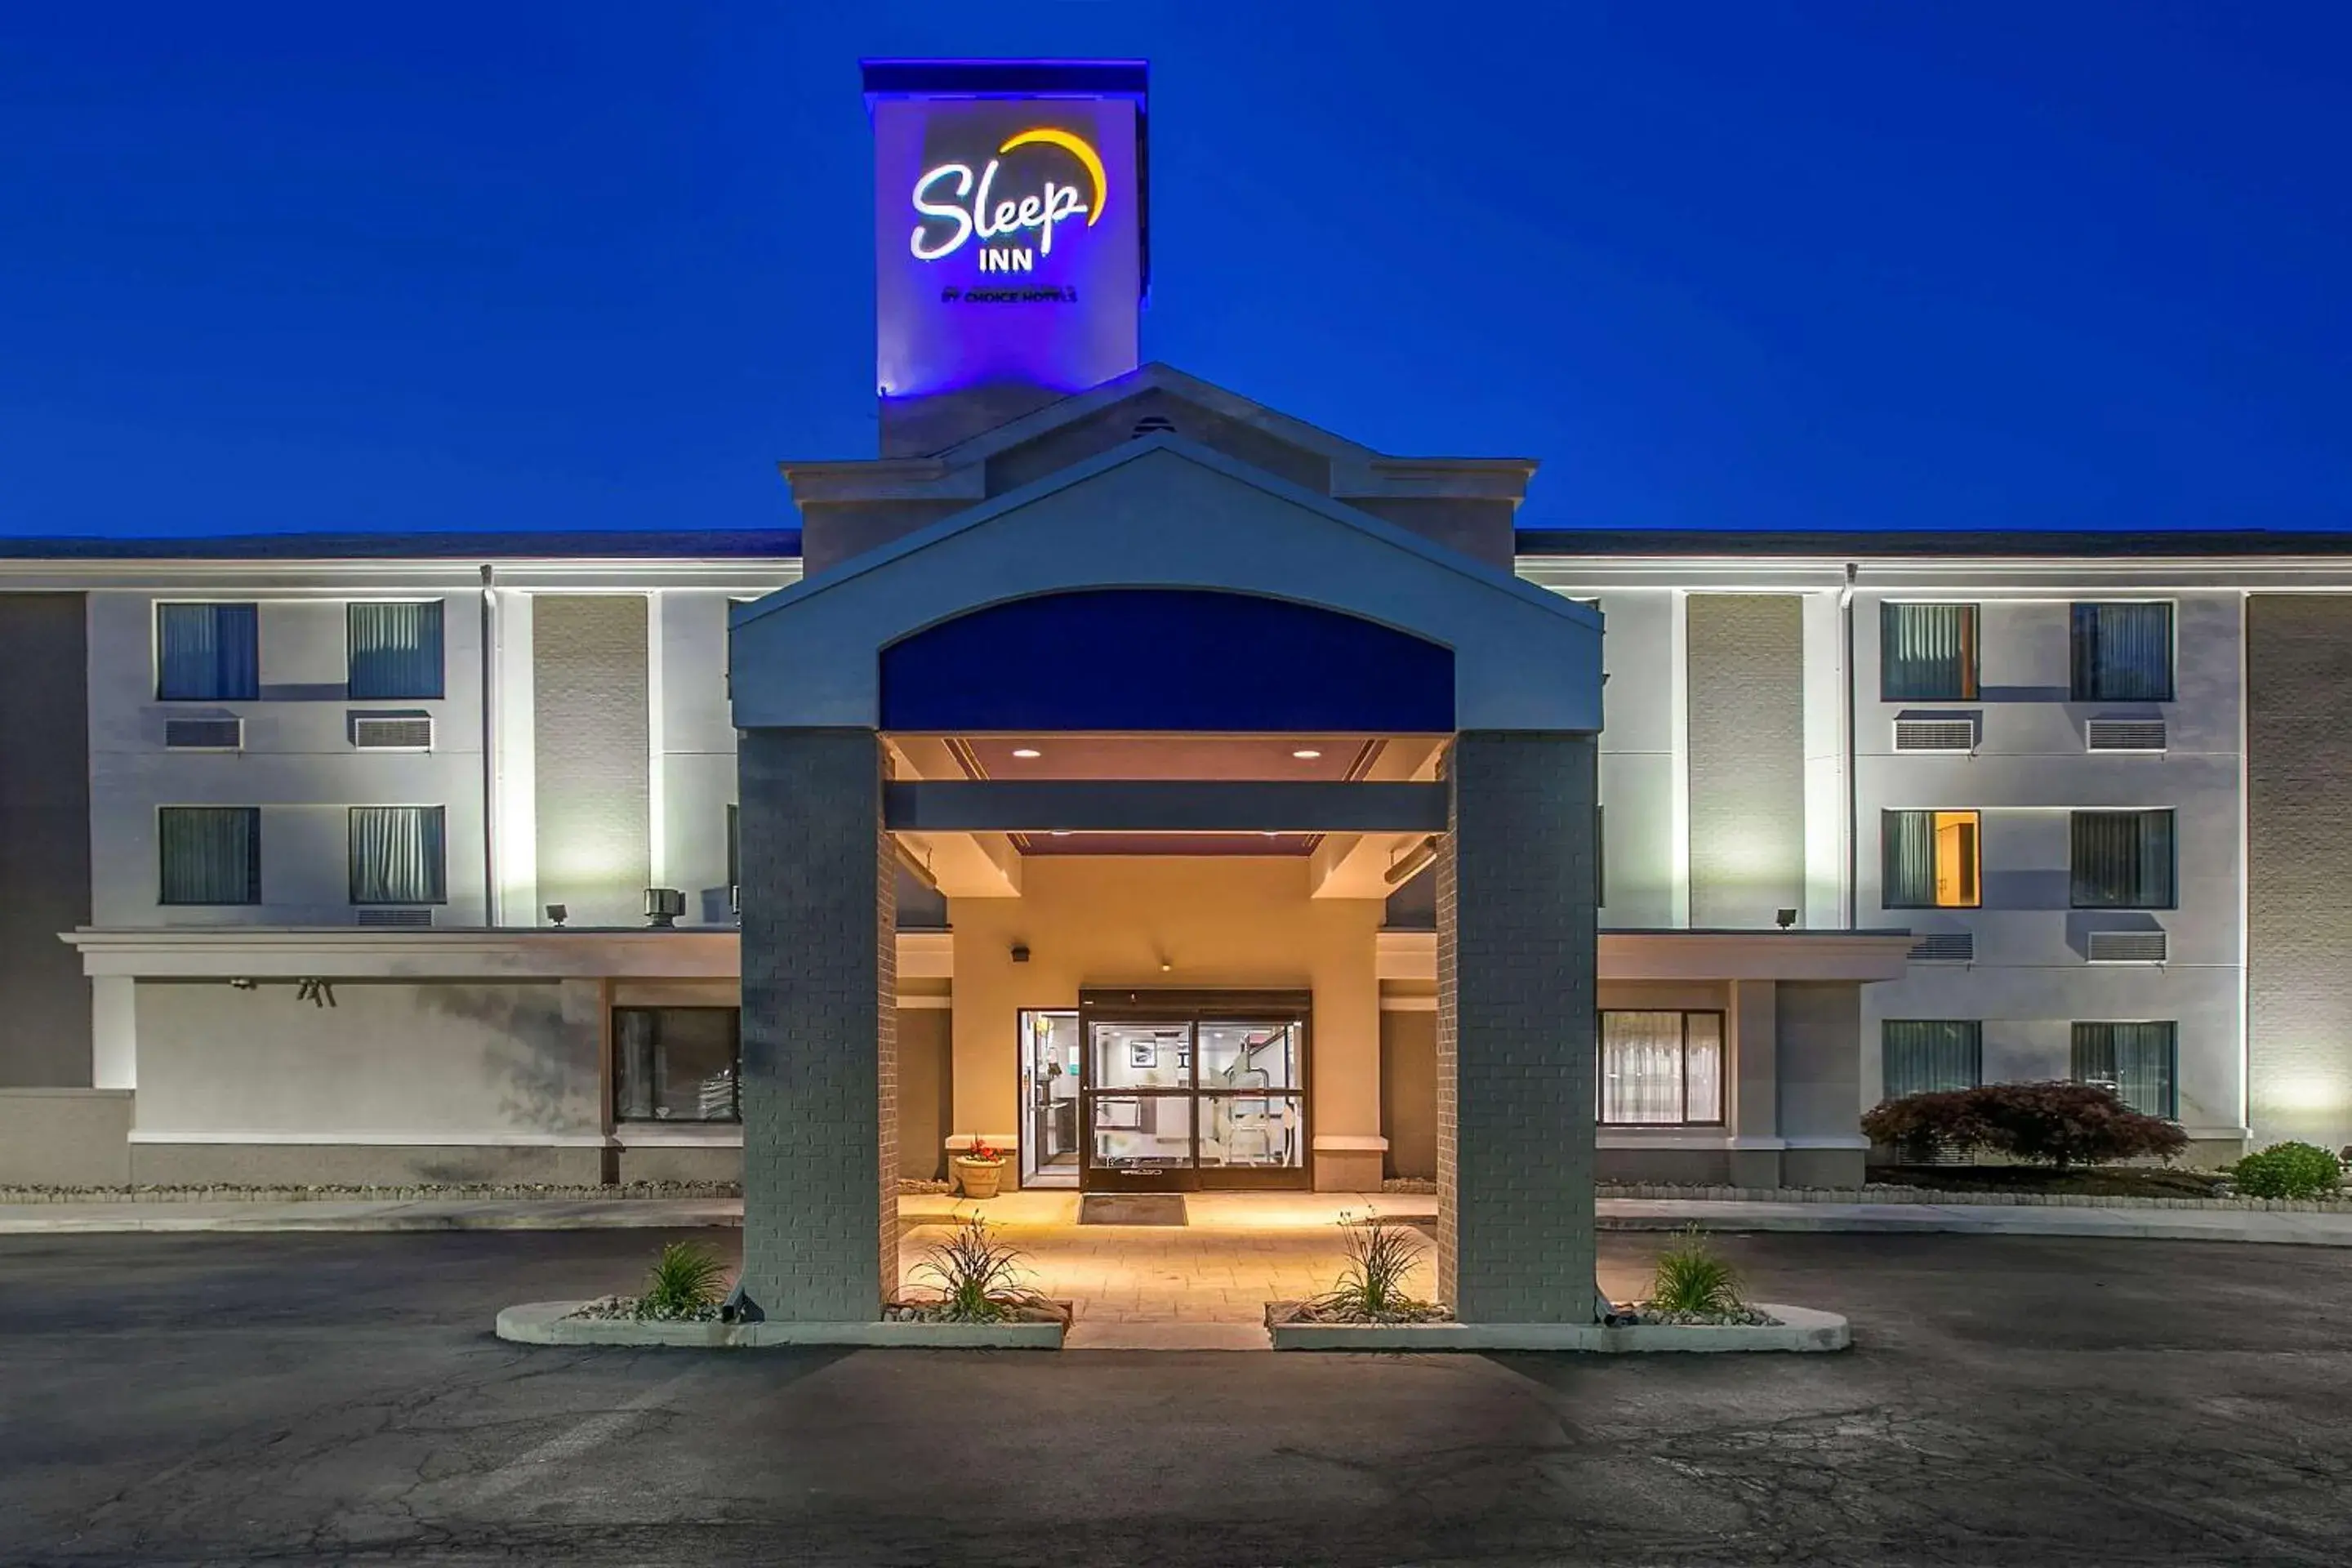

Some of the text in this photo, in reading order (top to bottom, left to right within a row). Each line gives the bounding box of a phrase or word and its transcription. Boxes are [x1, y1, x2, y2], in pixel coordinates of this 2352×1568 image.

[911, 160, 1089, 261] Sleep
[979, 248, 1033, 272] INN
[964, 289, 1018, 304] CHOICE
[1022, 289, 1078, 304] HOTELS
